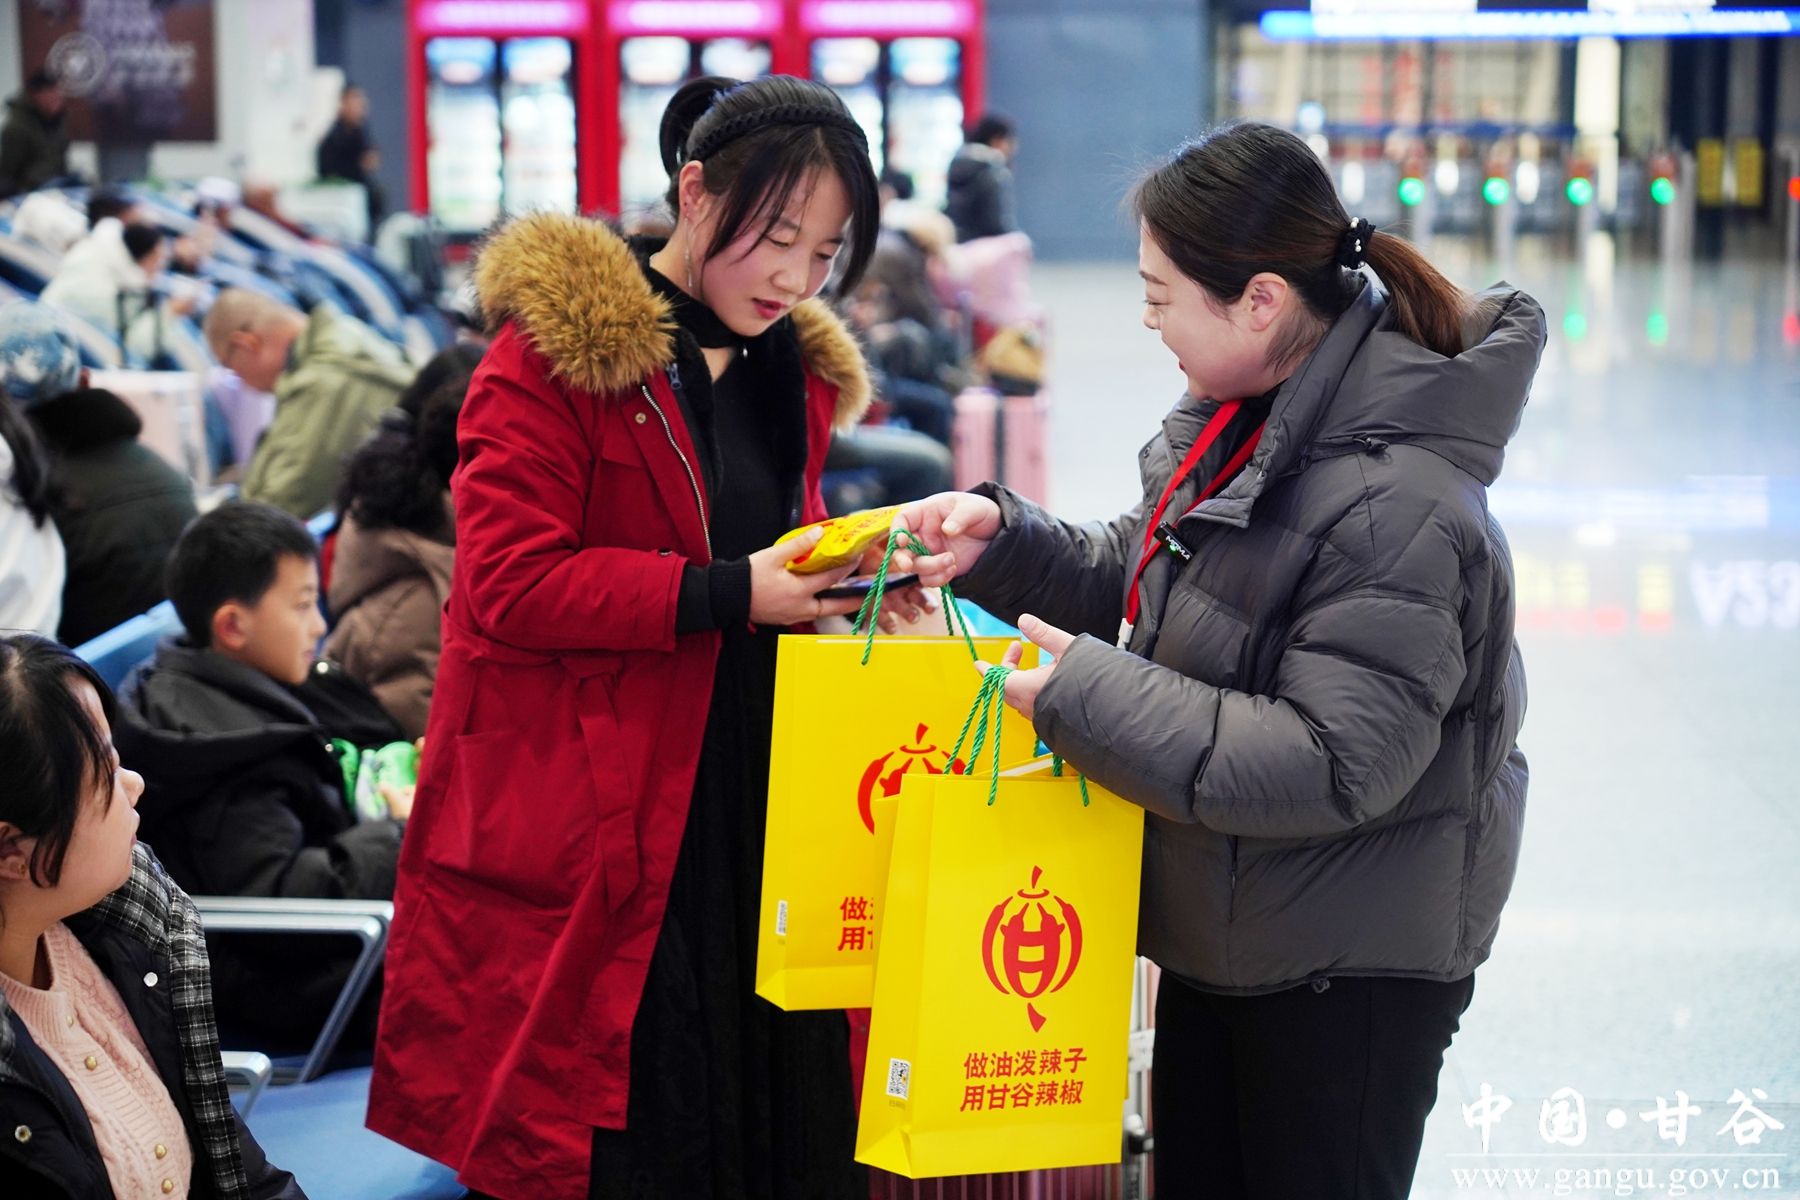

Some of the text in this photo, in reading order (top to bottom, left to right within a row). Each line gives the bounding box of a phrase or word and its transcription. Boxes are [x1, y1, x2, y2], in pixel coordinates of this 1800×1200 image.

[963, 1048, 1087, 1079] 做油泼辣子
[960, 1079, 1084, 1112] 用甘谷辣椒
